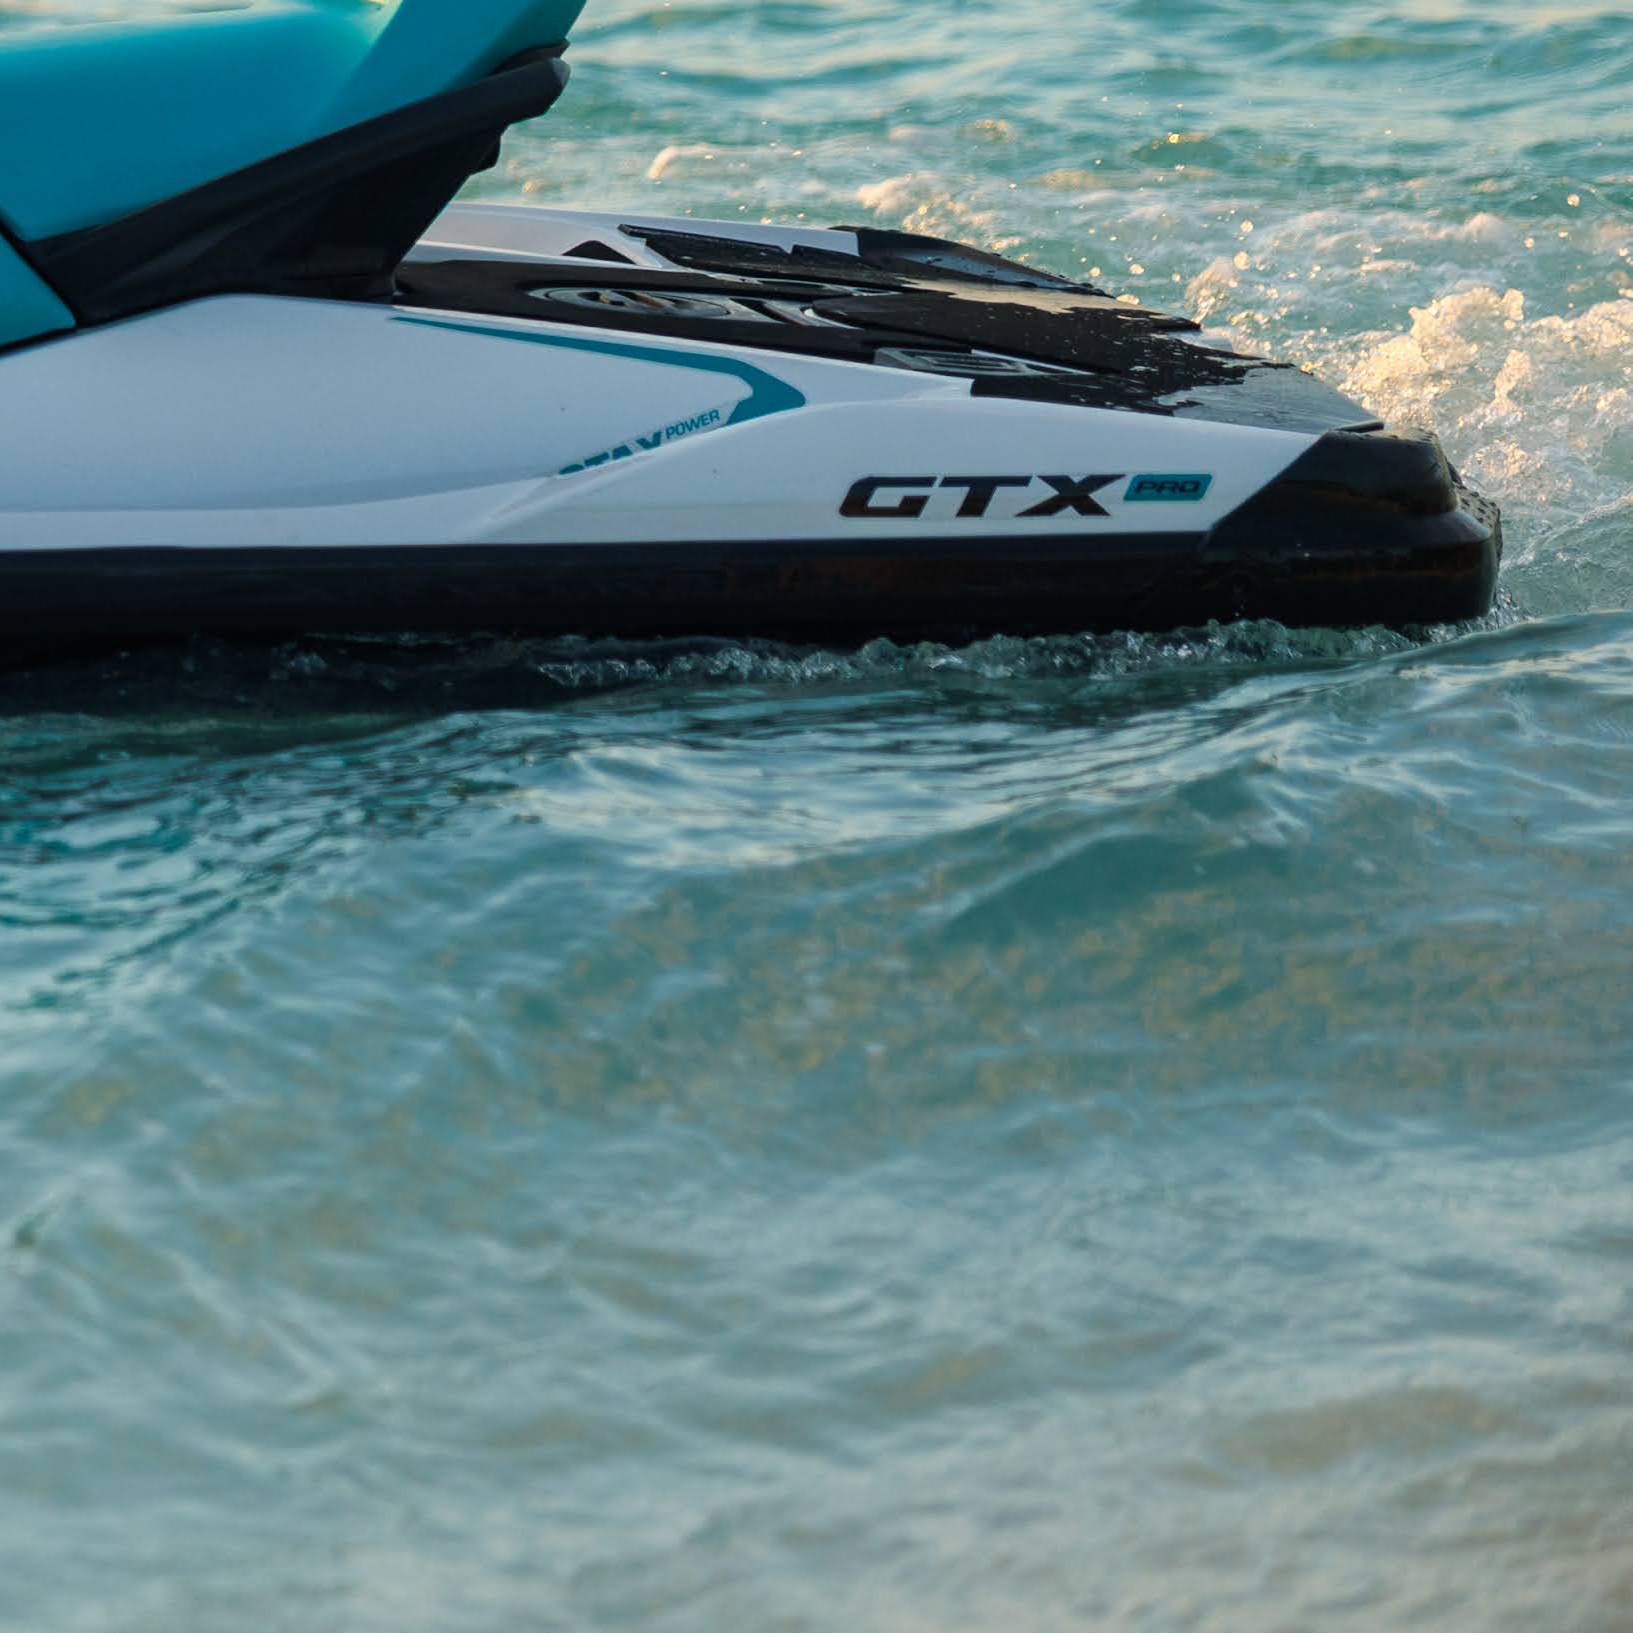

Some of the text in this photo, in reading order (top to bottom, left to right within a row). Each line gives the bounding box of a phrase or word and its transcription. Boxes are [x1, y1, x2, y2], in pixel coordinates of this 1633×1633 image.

[665, 409, 720, 440] POWER
[838, 473, 1202, 518] GTX PRO
